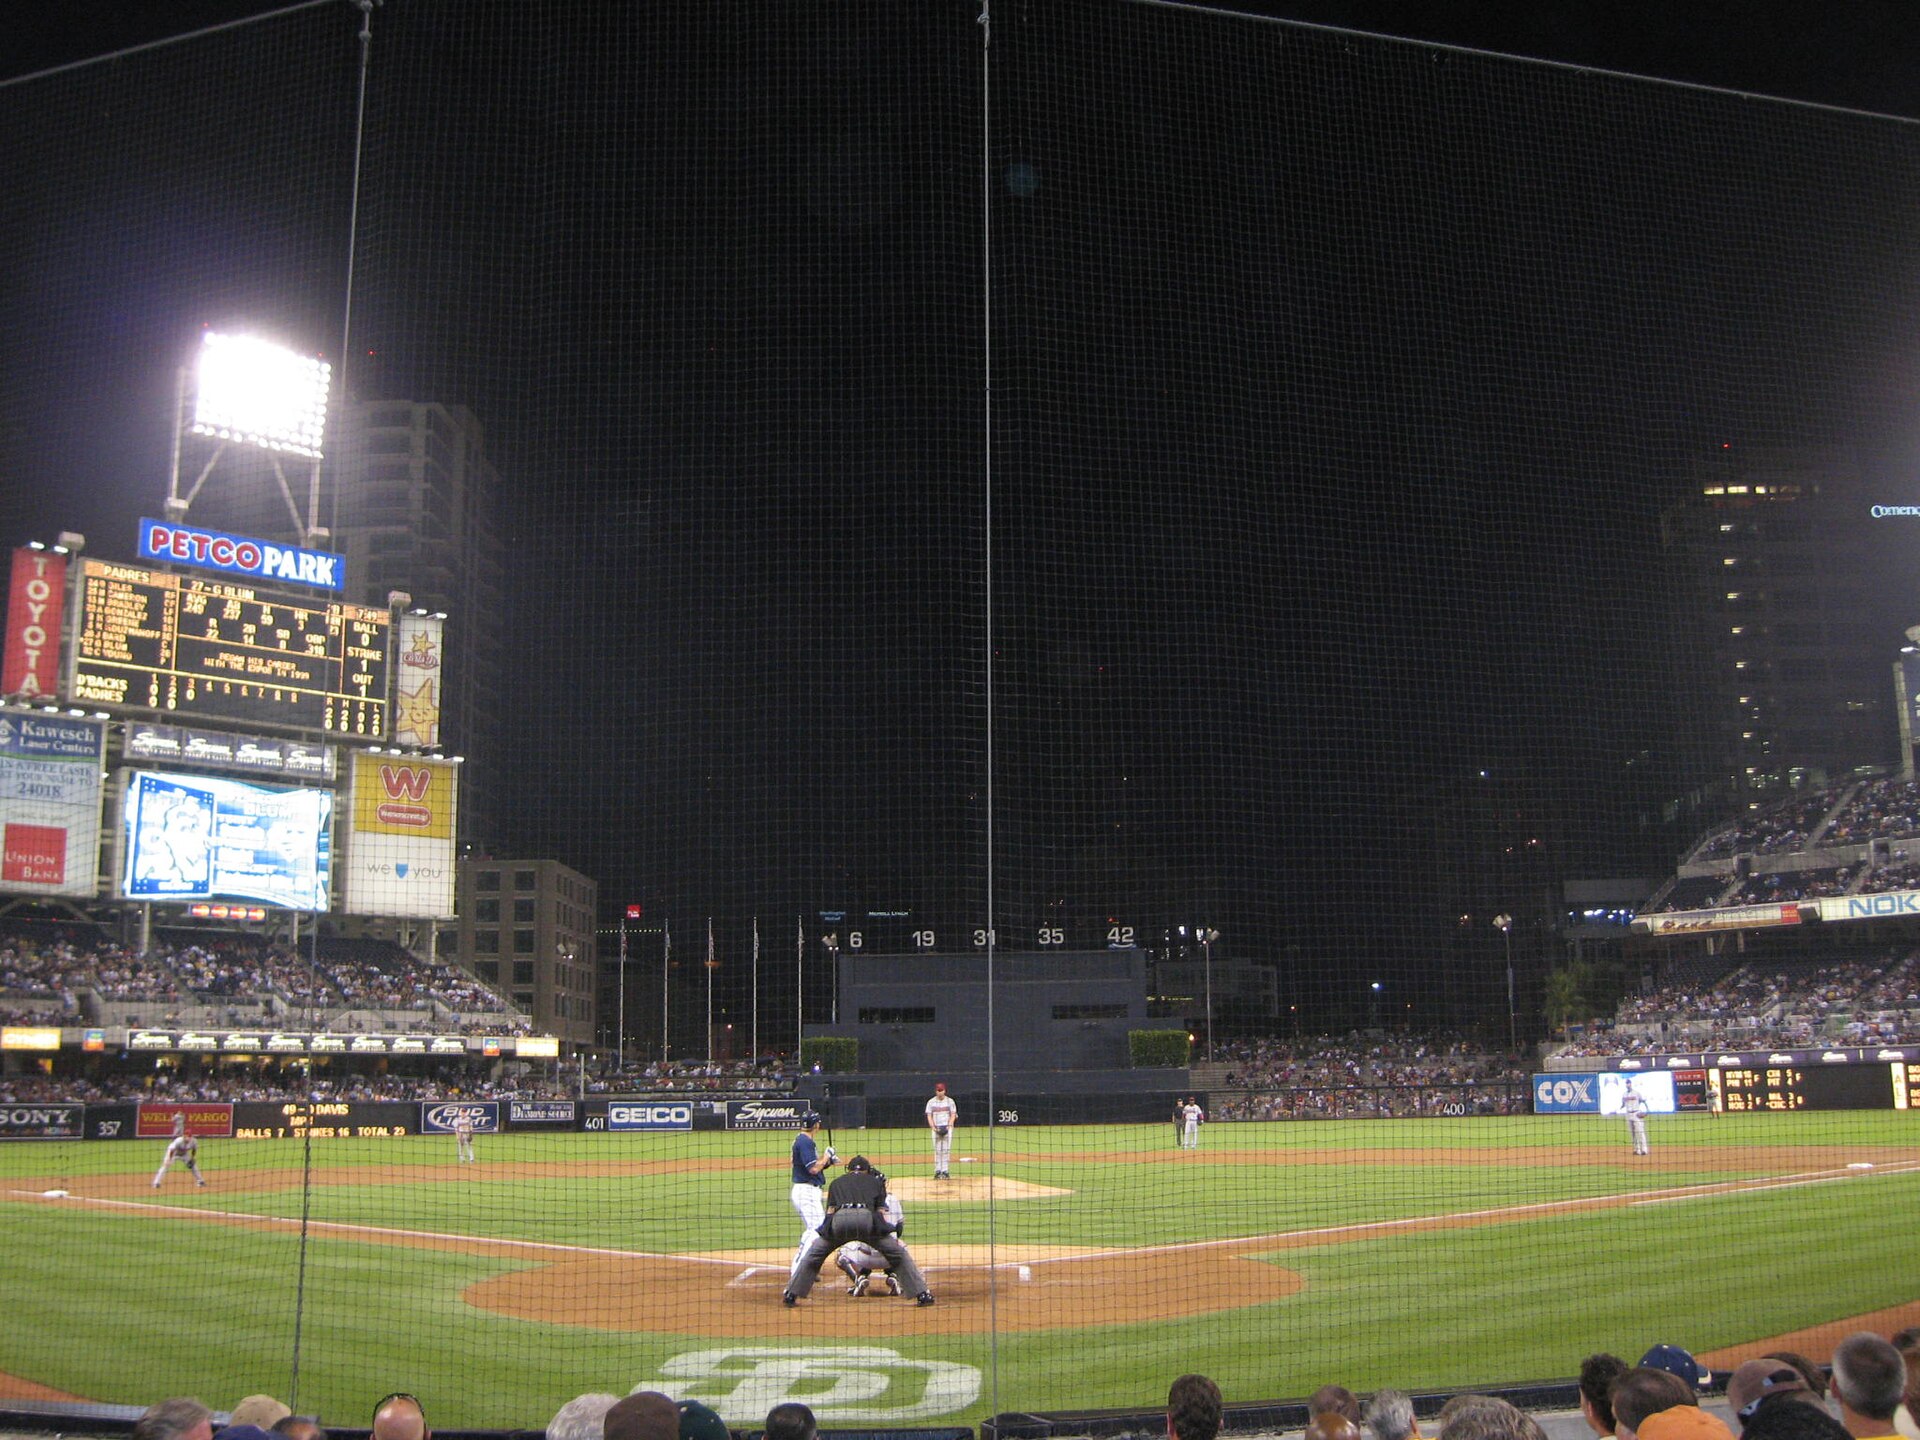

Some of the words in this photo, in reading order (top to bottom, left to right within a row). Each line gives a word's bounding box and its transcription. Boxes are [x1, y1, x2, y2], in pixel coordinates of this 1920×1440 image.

[150, 526, 261, 569] PETCO
[262, 547, 336, 587] PARK
[104, 565, 150, 583] PADRES
[191, 580, 204, 592] 27
[213, 585, 222, 595] G
[224, 586, 254, 600] BLUM
[20, 556, 50, 694] TOYOTA
[260, 614, 274, 626] 59
[298, 621, 305, 632] 3
[353, 621, 379, 635] BALL
[361, 633, 370, 647] 0
[347, 646, 383, 661] STRIKE
[360, 660, 368, 673] 1
[352, 673, 374, 685] OUT
[359, 685, 367, 697] 1
[76, 674, 128, 691] D'BACKS
[150, 684, 159, 695] 0
[168, 686, 177, 697] 2
[186, 689, 195, 700] 0
[325, 707, 334, 718] 2
[341, 709, 349, 720] 2
[357, 711, 365, 722] 0
[372, 713, 380, 724] 2
[76, 686, 124, 703] PADRES
[149, 696, 158, 708] 0
[167, 698, 176, 710] 0
[324, 719, 333, 730] 0
[340, 721, 349, 732] 0
[357, 723, 365, 734] 0
[372, 725, 380, 736] 0
[20, 720, 95, 742] Kawesch
[53, 740, 95, 754] Centers
[380, 765, 431, 801] W
[5, 851, 56, 864] UNION
[368, 863, 391, 875] we
[850, 932, 862, 947] 6
[912, 930, 935, 947] 19
[973, 929, 996, 946] 31
[1038, 928, 1064, 945] 35
[1106, 926, 1134, 943] 42
[1538, 1079, 1593, 1107] COX
[0, 1109, 71, 1124] SONY
[282, 1104, 297, 1115] 49
[316, 1104, 349, 1115] DAVIS
[443, 1106, 485, 1117] BUD
[611, 1107, 690, 1124] GEICO
[736, 1102, 800, 1124] Sycuan
[998, 1110, 1018, 1123] 396
[1443, 1103, 1465, 1115] 400
[189, 1112, 229, 1122] FARGO
[585, 1117, 604, 1130] 401
[98, 1121, 122, 1136] 357
[236, 1128, 272, 1139] BALLS
[278, 1128, 285, 1138] 7
[338, 1127, 350, 1137] 16
[357, 1127, 390, 1137] TOTAL
